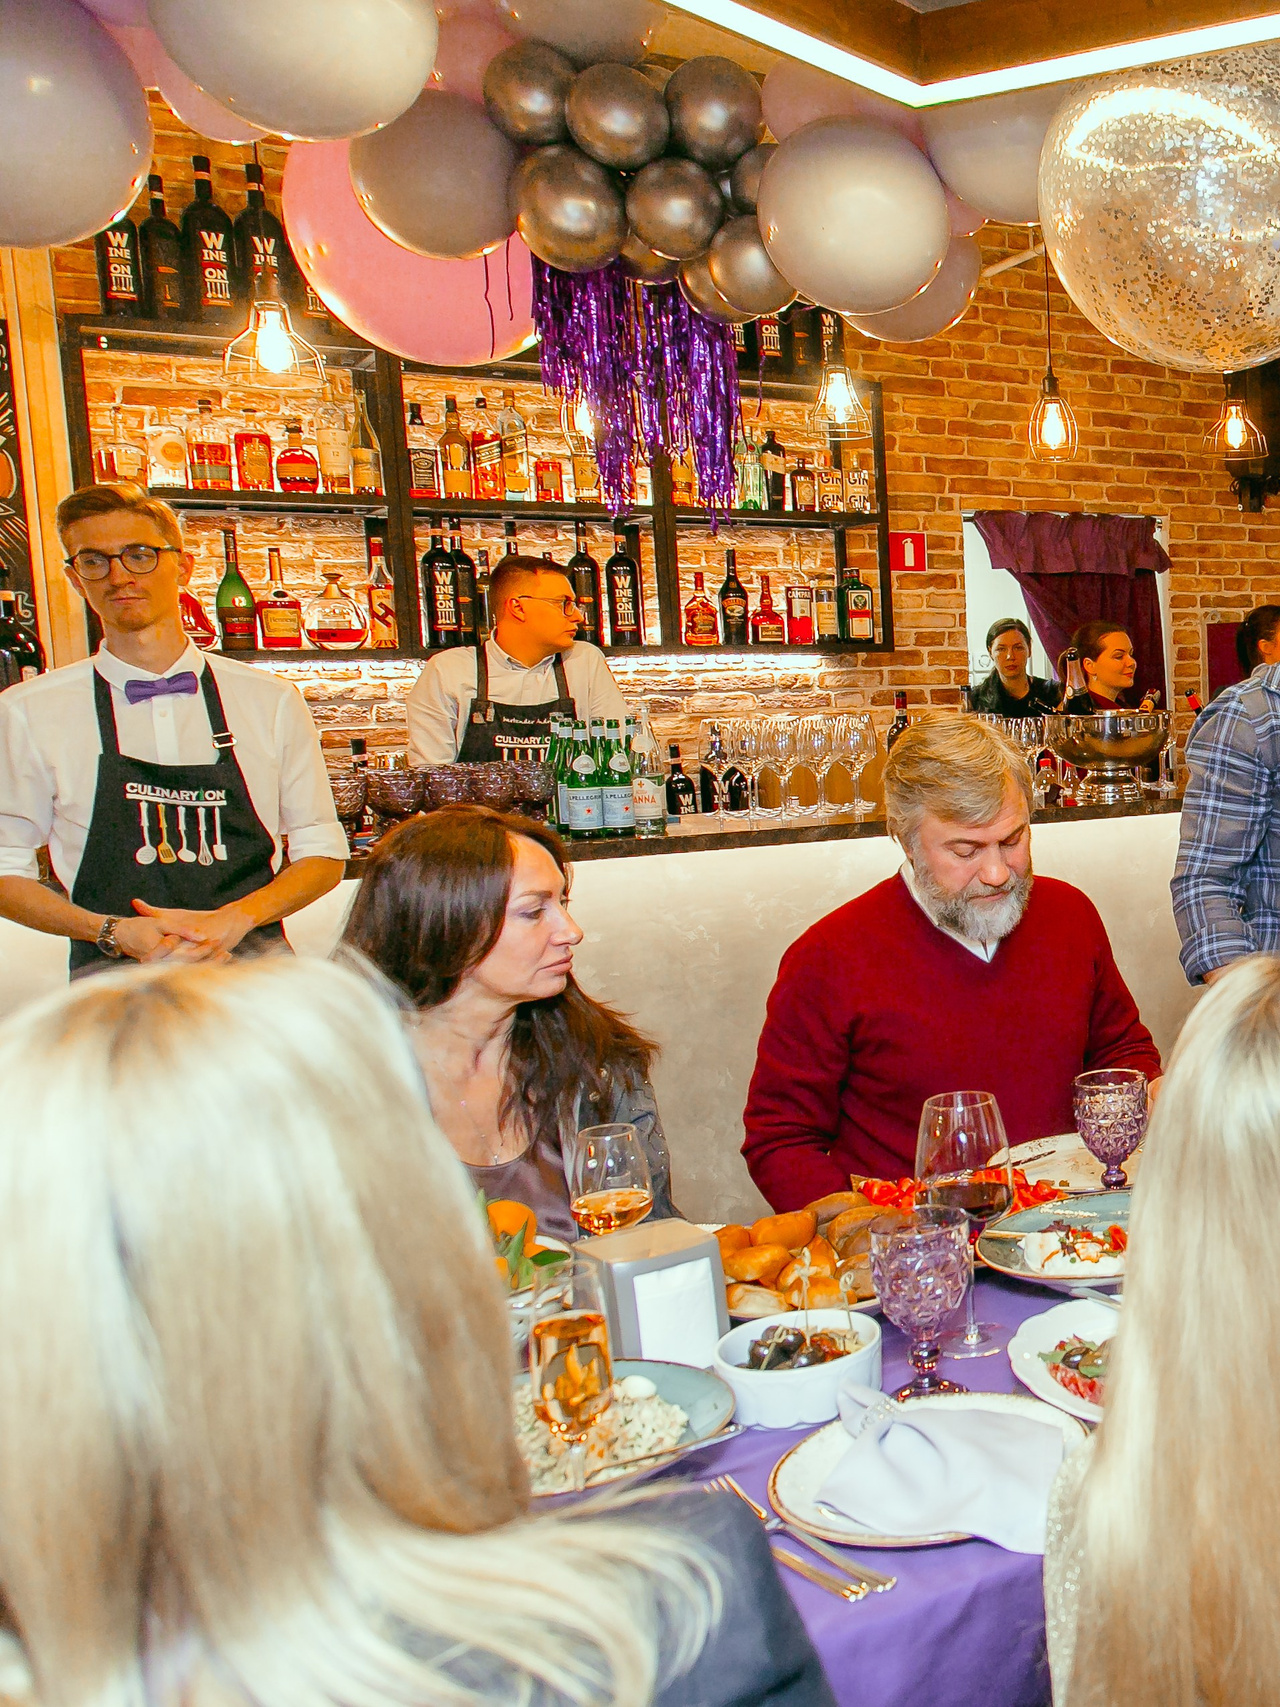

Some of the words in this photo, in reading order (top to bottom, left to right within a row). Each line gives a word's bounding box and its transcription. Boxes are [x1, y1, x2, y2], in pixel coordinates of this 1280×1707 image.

[106, 231, 129, 248] W
[199, 230, 225, 251] W
[107, 246, 131, 259] INE
[202, 249, 228, 264] INE
[110, 263, 131, 276] ON
[204, 267, 228, 281] ON
[434, 570, 453, 585] W
[614, 575, 632, 589] W
[435, 585, 454, 594] INE
[615, 588, 633, 598] INE
[436, 599, 454, 609] ON
[616, 601, 633, 612] ON
[494, 734, 542, 745] CULINARY
[125, 782, 200, 801] CULINARY
[204, 789, 226, 801] ON
[633, 795, 657, 804] ANNA
[678, 794, 694, 806] W
